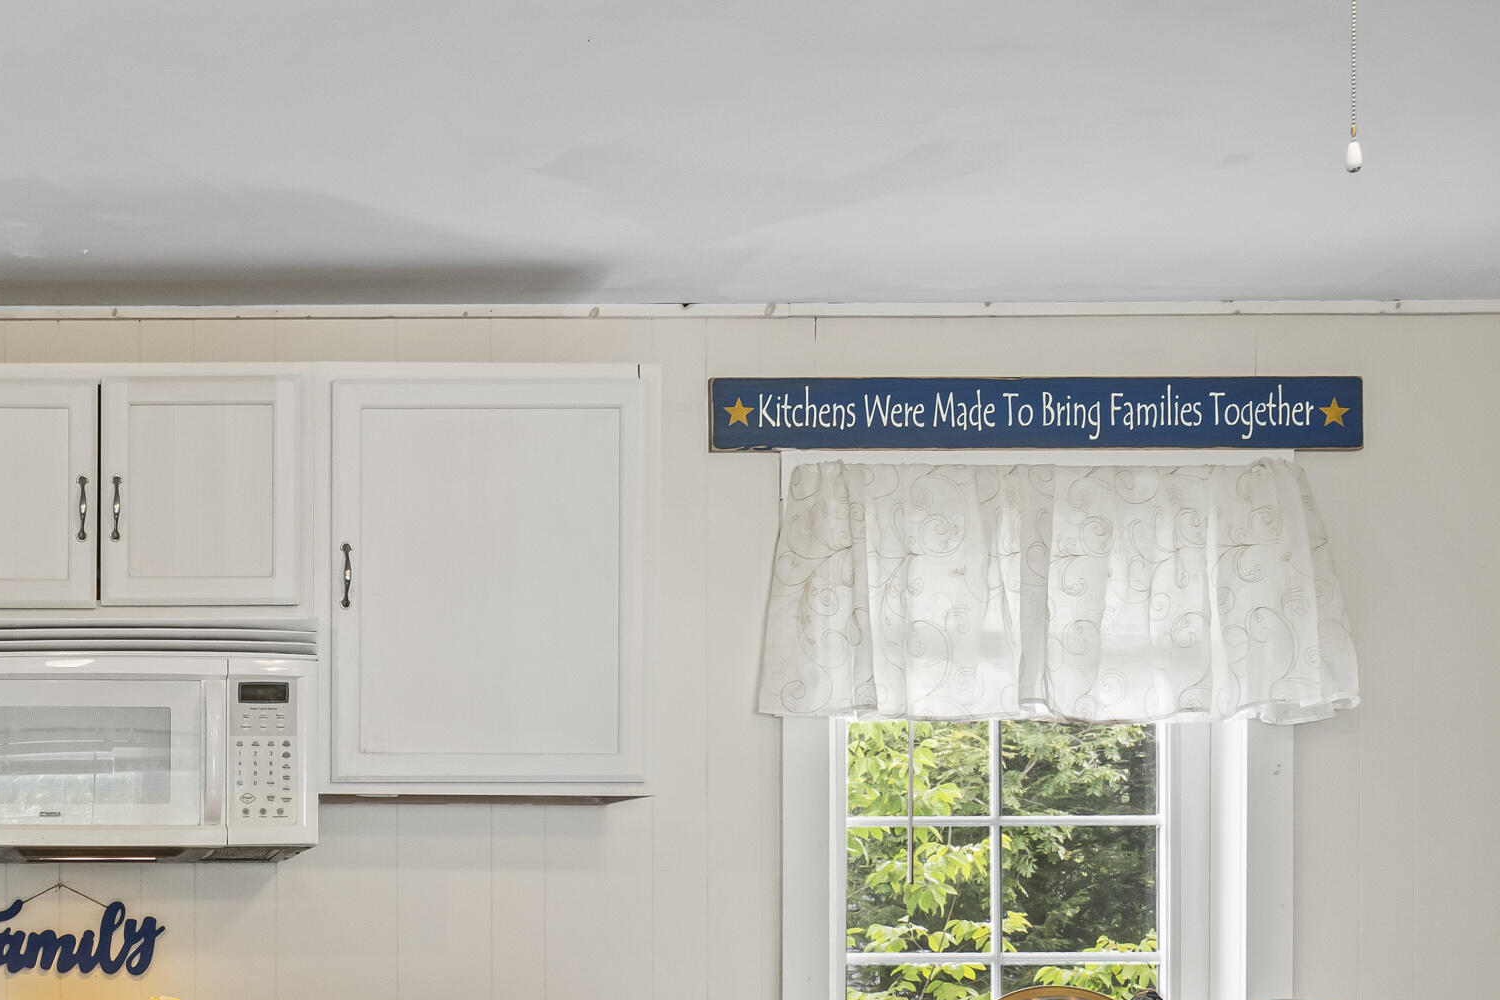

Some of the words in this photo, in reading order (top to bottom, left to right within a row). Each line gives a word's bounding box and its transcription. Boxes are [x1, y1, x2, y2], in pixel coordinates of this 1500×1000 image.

[757, 385, 856, 431] Kitchens
[863, 393, 925, 428] Were
[933, 389, 996, 432] Made
[1002, 392, 1034, 428] To
[1042, 391, 1101, 441] Bring
[1109, 384, 1202, 431] Families
[1208, 384, 1315, 440] Together
